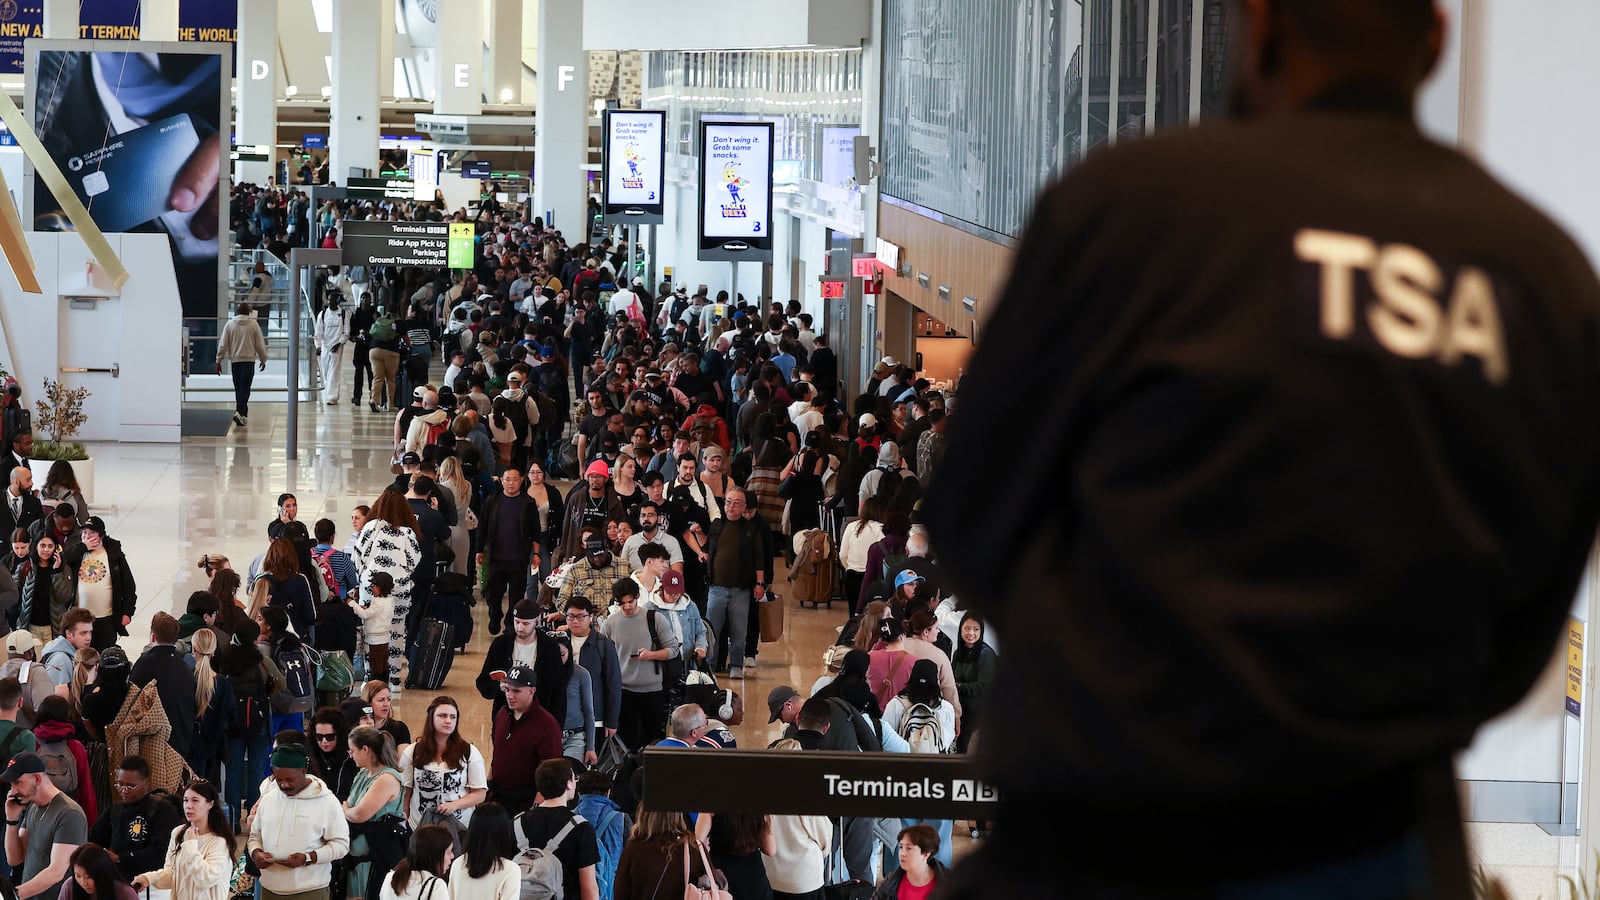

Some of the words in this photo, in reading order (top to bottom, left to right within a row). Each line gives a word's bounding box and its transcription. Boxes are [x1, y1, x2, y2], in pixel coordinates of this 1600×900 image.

[1, 24, 30, 37] NEW
[252, 60, 268, 80] D
[454, 64, 469, 87] E
[558, 66, 574, 91] F
[84, 141, 124, 160] SAPPHIRE
[396, 257, 446, 266] Transportation
[1293, 228, 1510, 385] TSA
[510, 668, 520, 679] NY
[824, 774, 945, 799] Terminals
